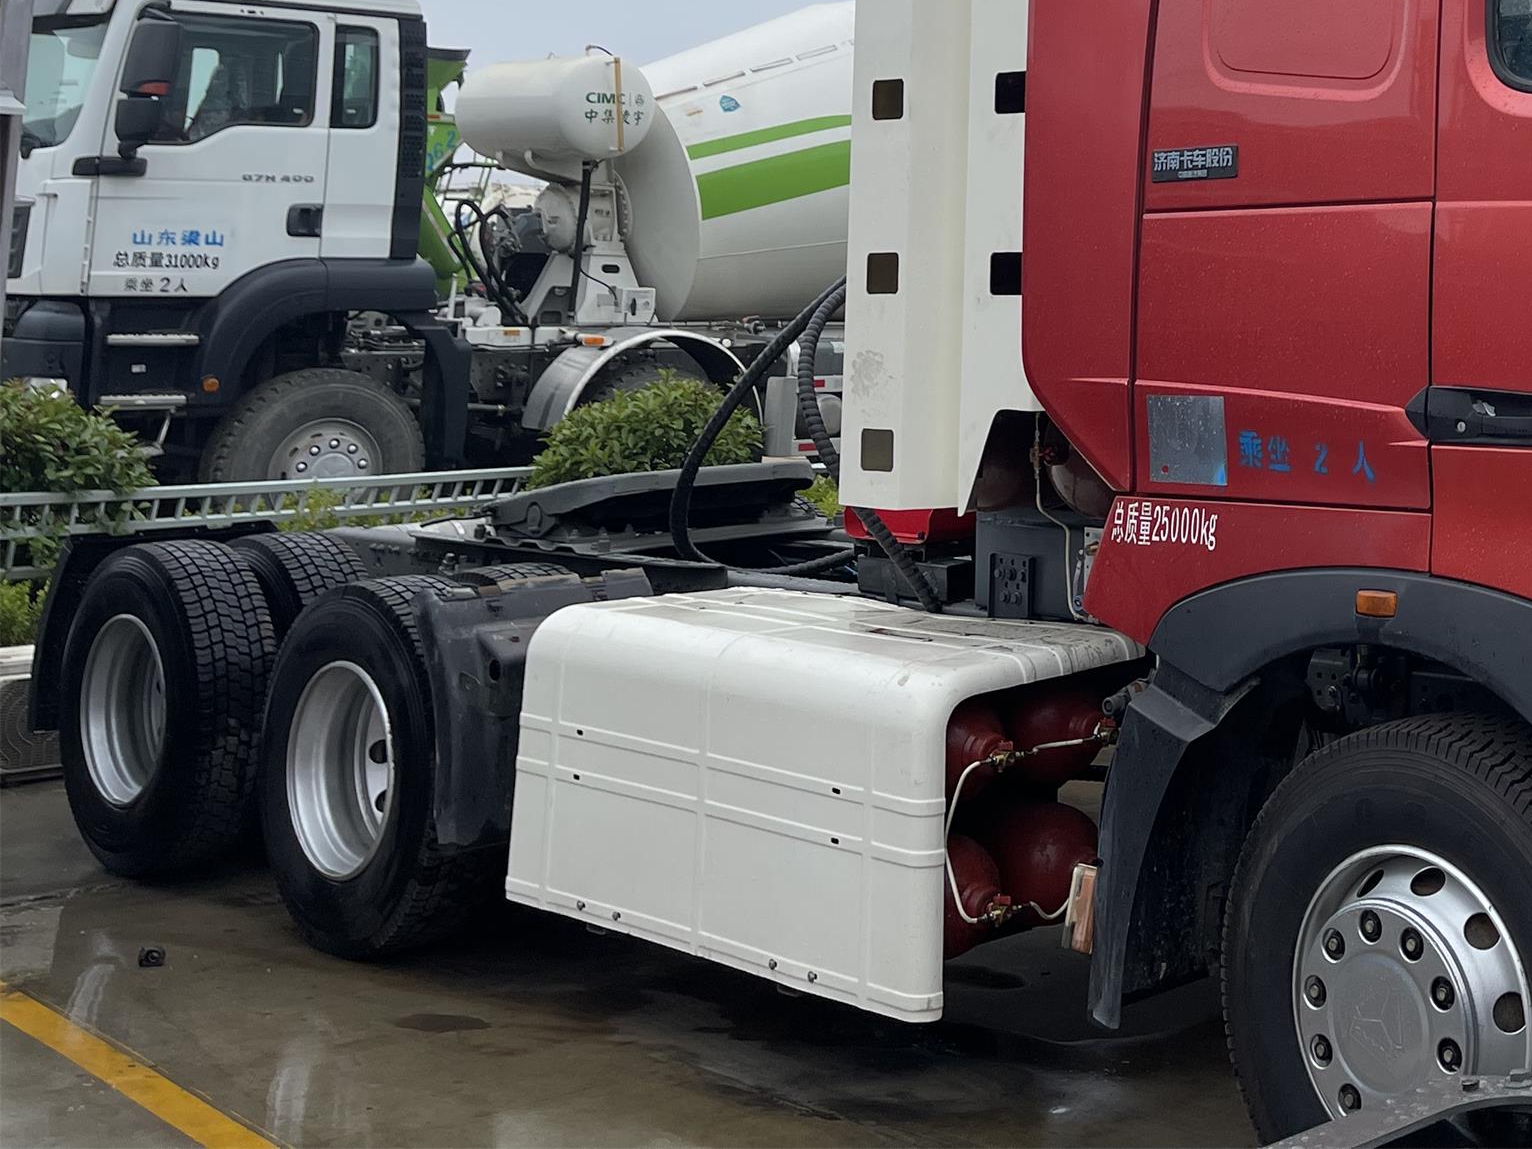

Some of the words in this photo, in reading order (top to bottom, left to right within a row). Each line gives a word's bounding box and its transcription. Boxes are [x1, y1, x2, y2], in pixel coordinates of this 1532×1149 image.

[1153, 147, 1233, 171] 济南卡车股份
[132, 229, 225, 247] 山东梁山
[112, 251, 220, 270] 总质量31000kg
[1110, 501, 1218, 551] 总质量25000kg
